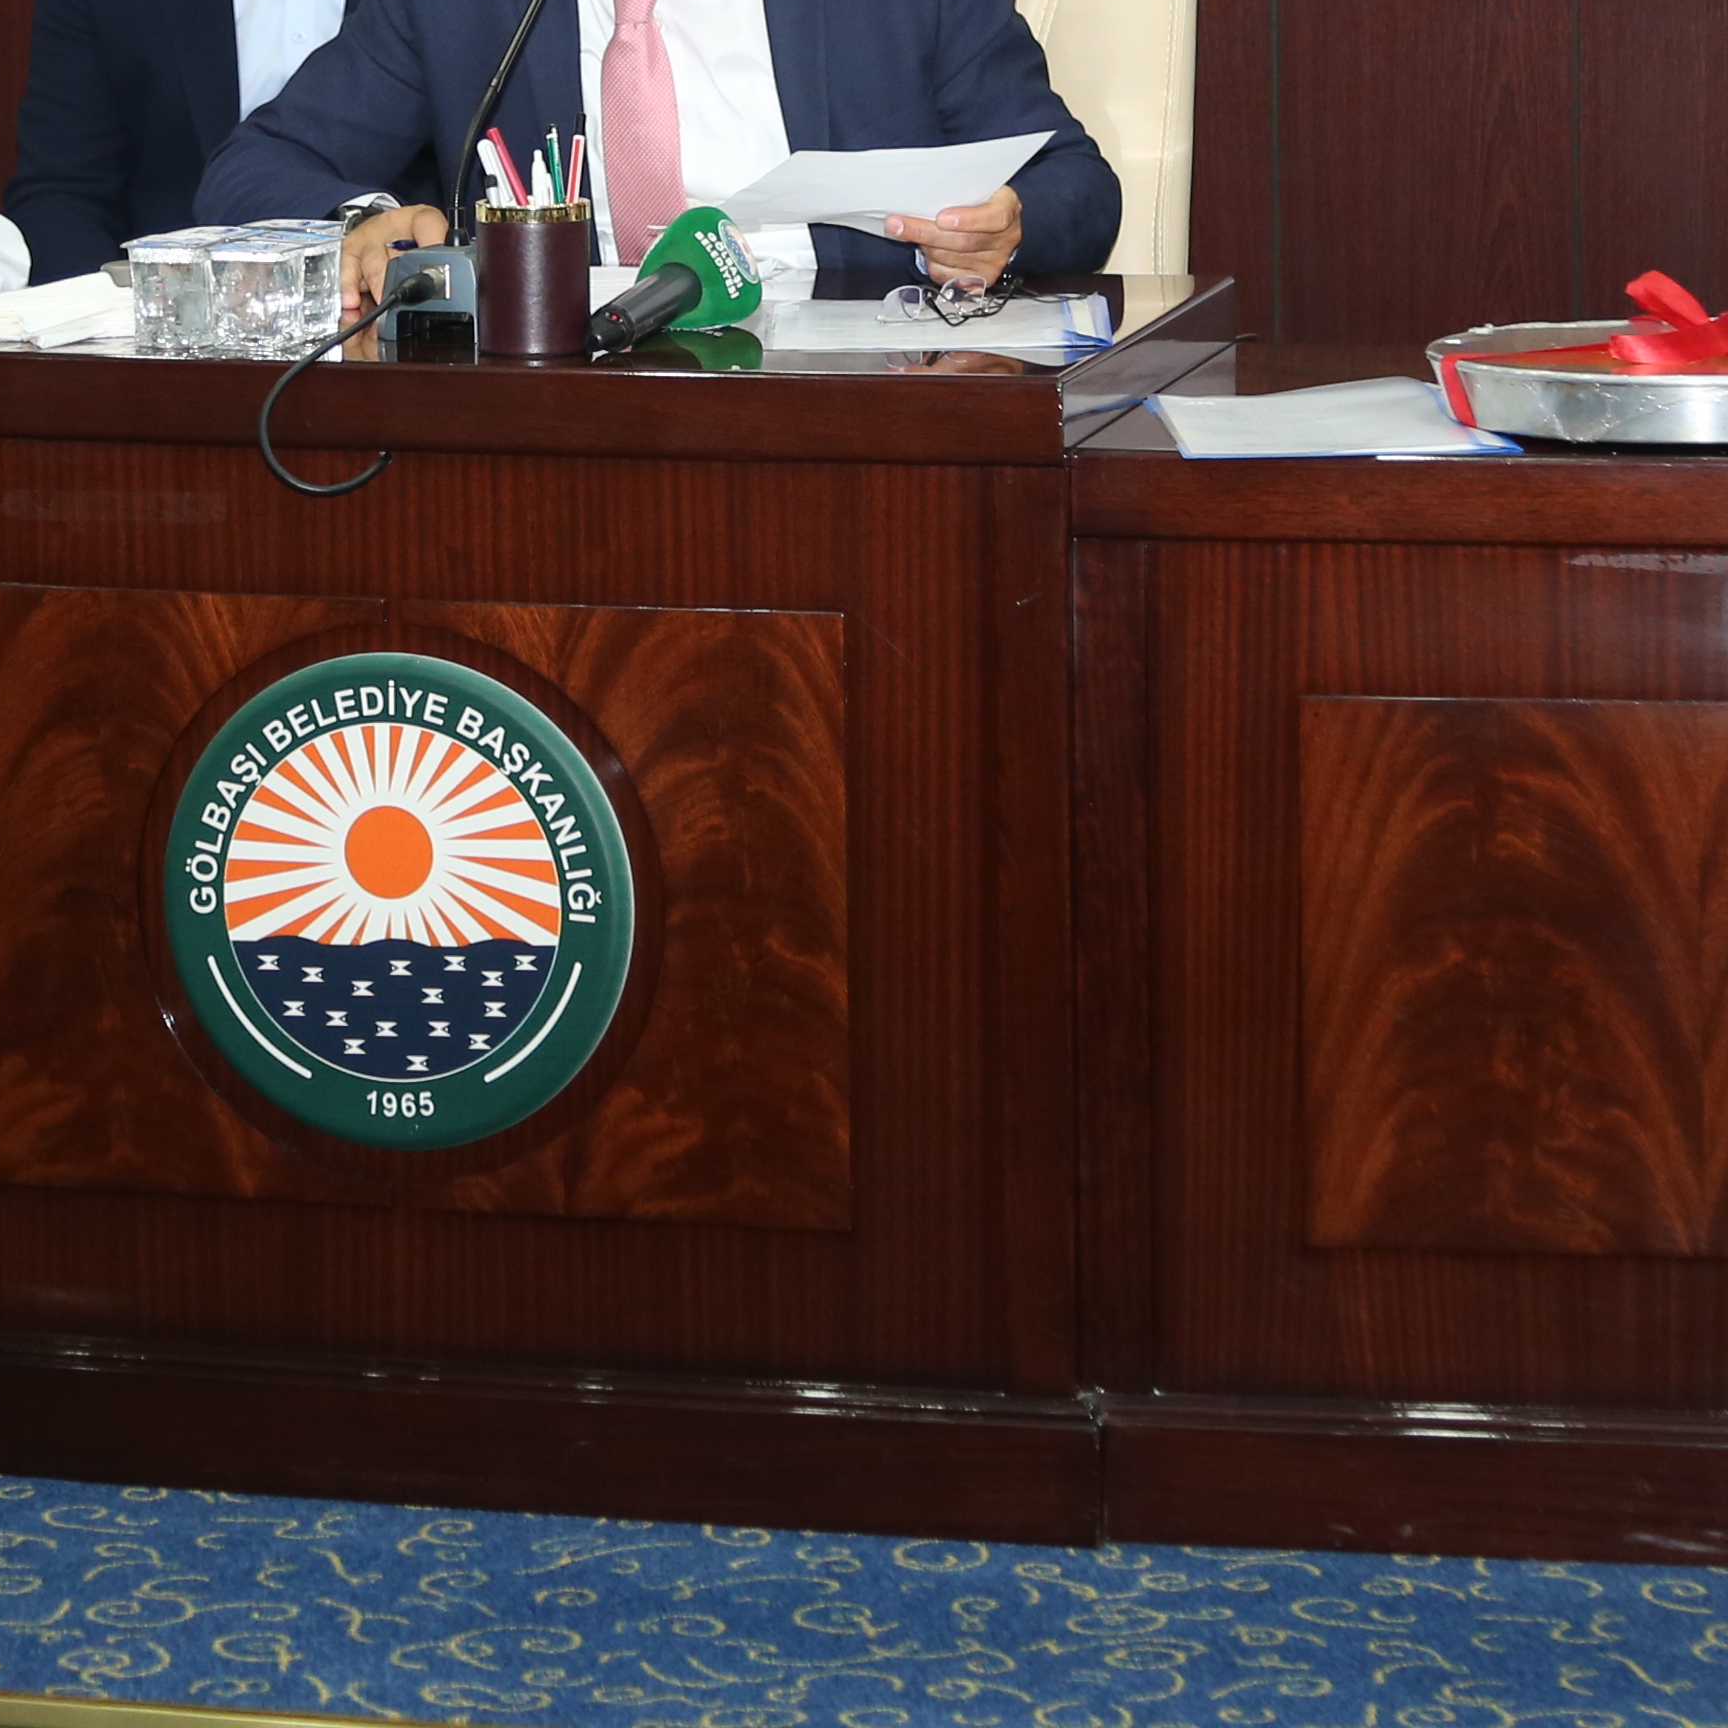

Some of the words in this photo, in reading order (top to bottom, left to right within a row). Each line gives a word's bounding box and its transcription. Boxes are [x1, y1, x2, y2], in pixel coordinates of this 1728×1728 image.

[185, 742, 268, 915] GÖLBAŞI
[261, 679, 450, 754] BELEDİYE
[455, 705, 603, 924] BAŞKANLIĞI
[365, 1089, 436, 1119] 1965
